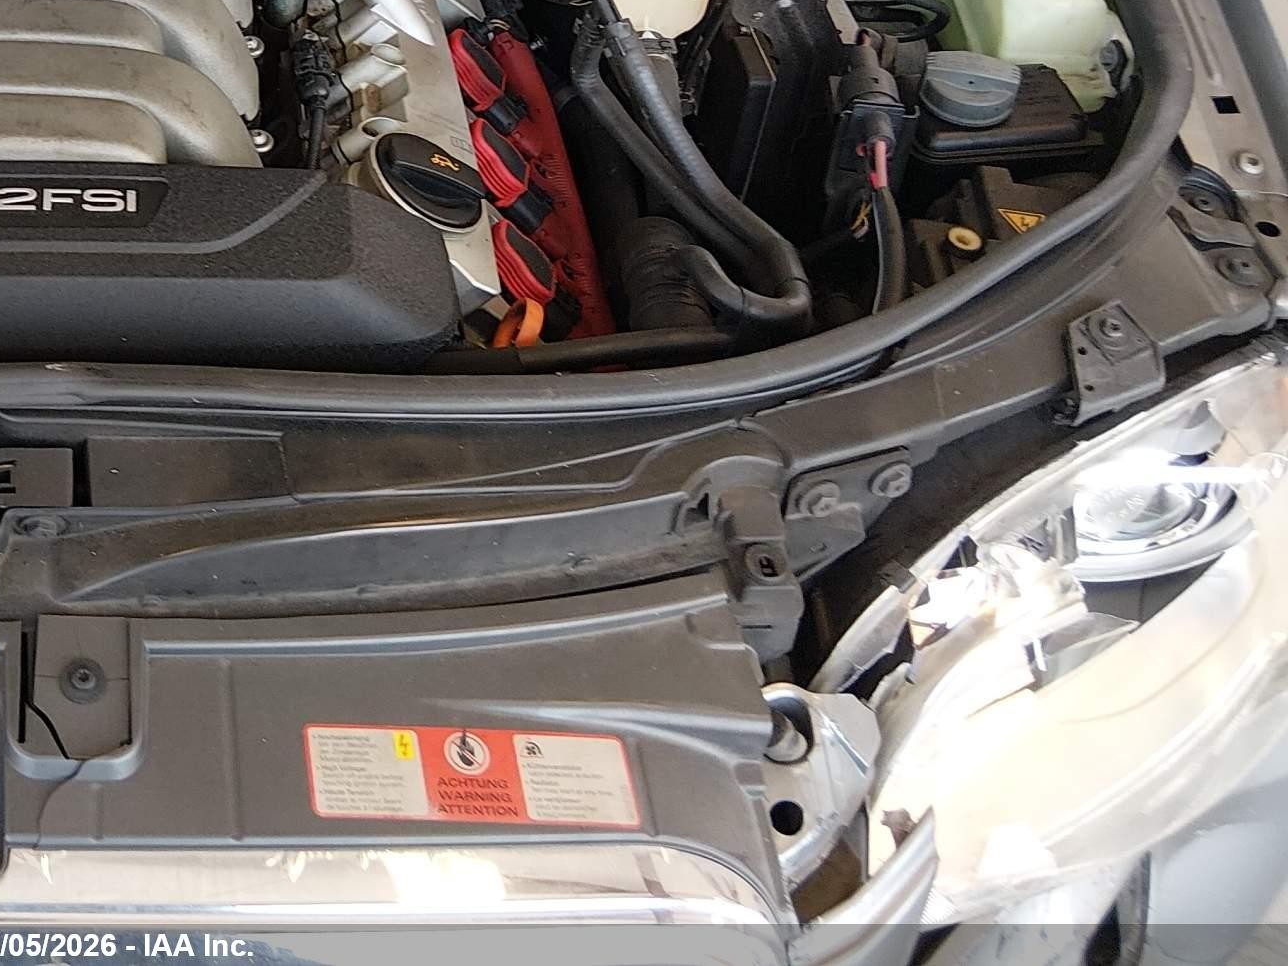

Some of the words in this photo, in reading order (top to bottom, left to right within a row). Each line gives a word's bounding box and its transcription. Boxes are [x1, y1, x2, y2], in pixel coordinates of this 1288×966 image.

[437, 777, 510, 789] ACHTUNG
[438, 790, 513, 803] WARNING
[438, 803, 519, 817] ATTENTION
